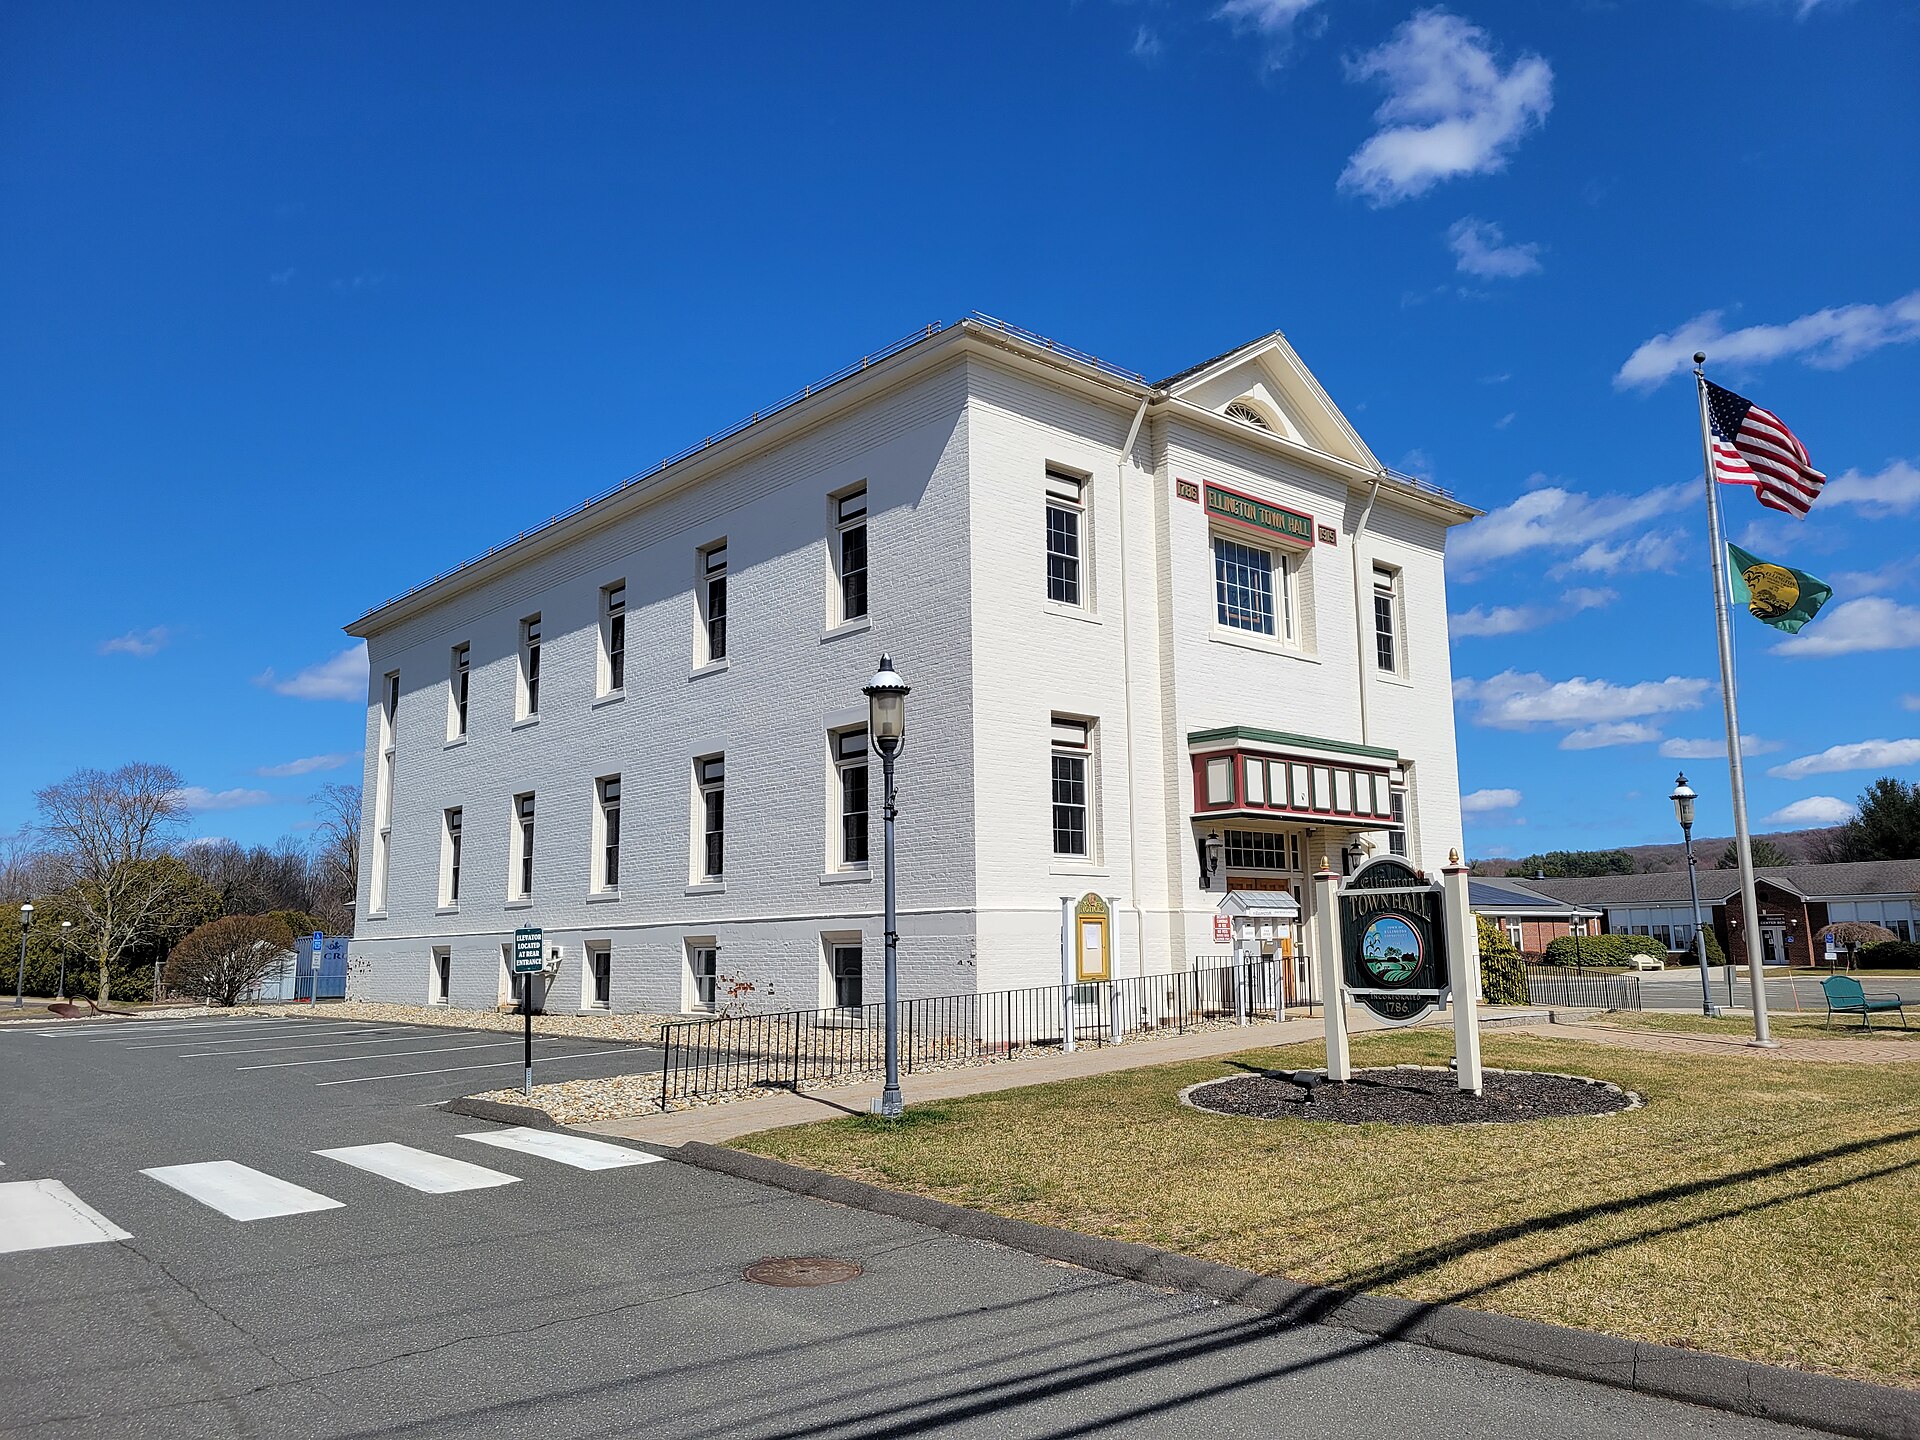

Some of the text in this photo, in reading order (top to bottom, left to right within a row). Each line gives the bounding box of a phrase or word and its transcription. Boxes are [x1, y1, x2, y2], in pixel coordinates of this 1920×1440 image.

[1177, 481, 1198, 500] 1786
[1207, 490, 1311, 538] ELLINGTON TOWN HALL
[1350, 892, 1431, 922] TOWN HALL
